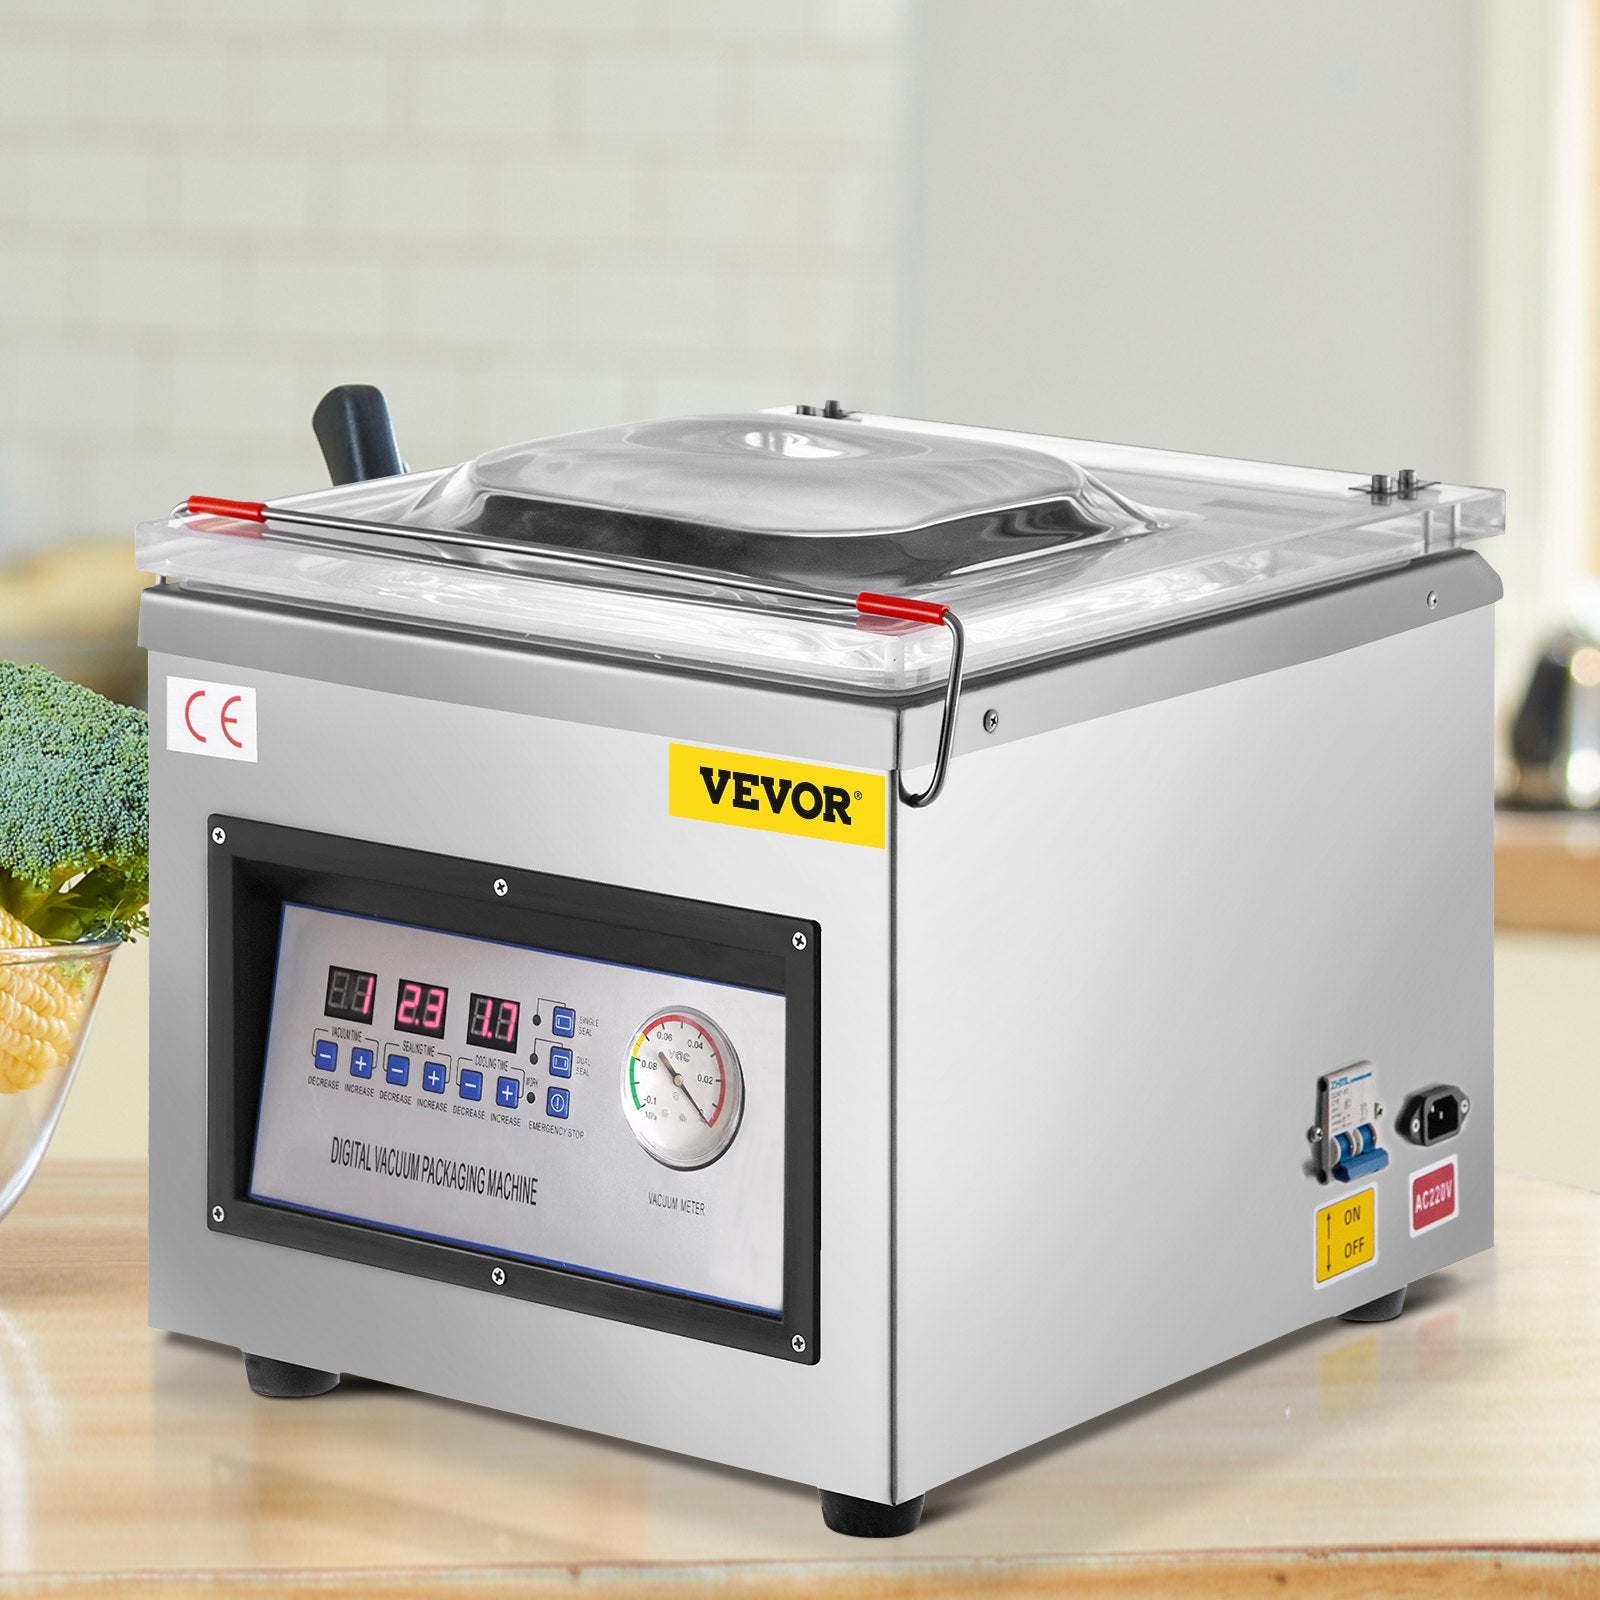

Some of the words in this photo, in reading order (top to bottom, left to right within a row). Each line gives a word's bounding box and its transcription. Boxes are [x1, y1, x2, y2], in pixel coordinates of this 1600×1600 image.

[699, 766, 852, 825] VEVOR
[397, 984, 446, 1028] 2.3
[480, 999, 519, 1042] 1.7
[579, 1016, 600, 1028] SINGLE
[331, 1026, 351, 1040] VACUUM
[351, 1031, 363, 1043] TIME
[578, 1027, 592, 1037] SEAL
[656, 1031, 673, 1042] 0.06
[402, 1040, 423, 1055] SEALING
[423, 1045, 435, 1058] TIME
[687, 1039, 704, 1050] 0.04
[475, 1055, 497, 1070] COOLING
[497, 1059, 509, 1072] TIME
[576, 1056, 591, 1066] DUAL
[641, 1060, 658, 1071] 0.08
[576, 1067, 590, 1077] SEAL
[697, 1074, 714, 1085] 0.02
[307, 1075, 340, 1091] DECREASE
[344, 1083, 375, 1098] INCREASE
[526, 1077, 539, 1088] WORK
[379, 1090, 412, 1106] DECREASE
[417, 1098, 448, 1113] INCREASE
[452, 1105, 486, 1120] DECREASE
[490, 1113, 521, 1128] INCREASE
[528, 1120, 567, 1136] EMERGENCY
[567, 1128, 585, 1140] STOP
[331, 1136, 371, 1172] DIGITAL
[375, 1145, 421, 1181] VACUUM
[421, 1155, 485, 1195] PACKAGING
[486, 1169, 538, 1206] MACHINE
[648, 1191, 678, 1210] VACUUM
[680, 1196, 706, 1216] METER
[1415, 1179, 1453, 1214] AC220V
[1344, 1205, 1361, 1225] ON
[1344, 1236, 1365, 1259] OFF
